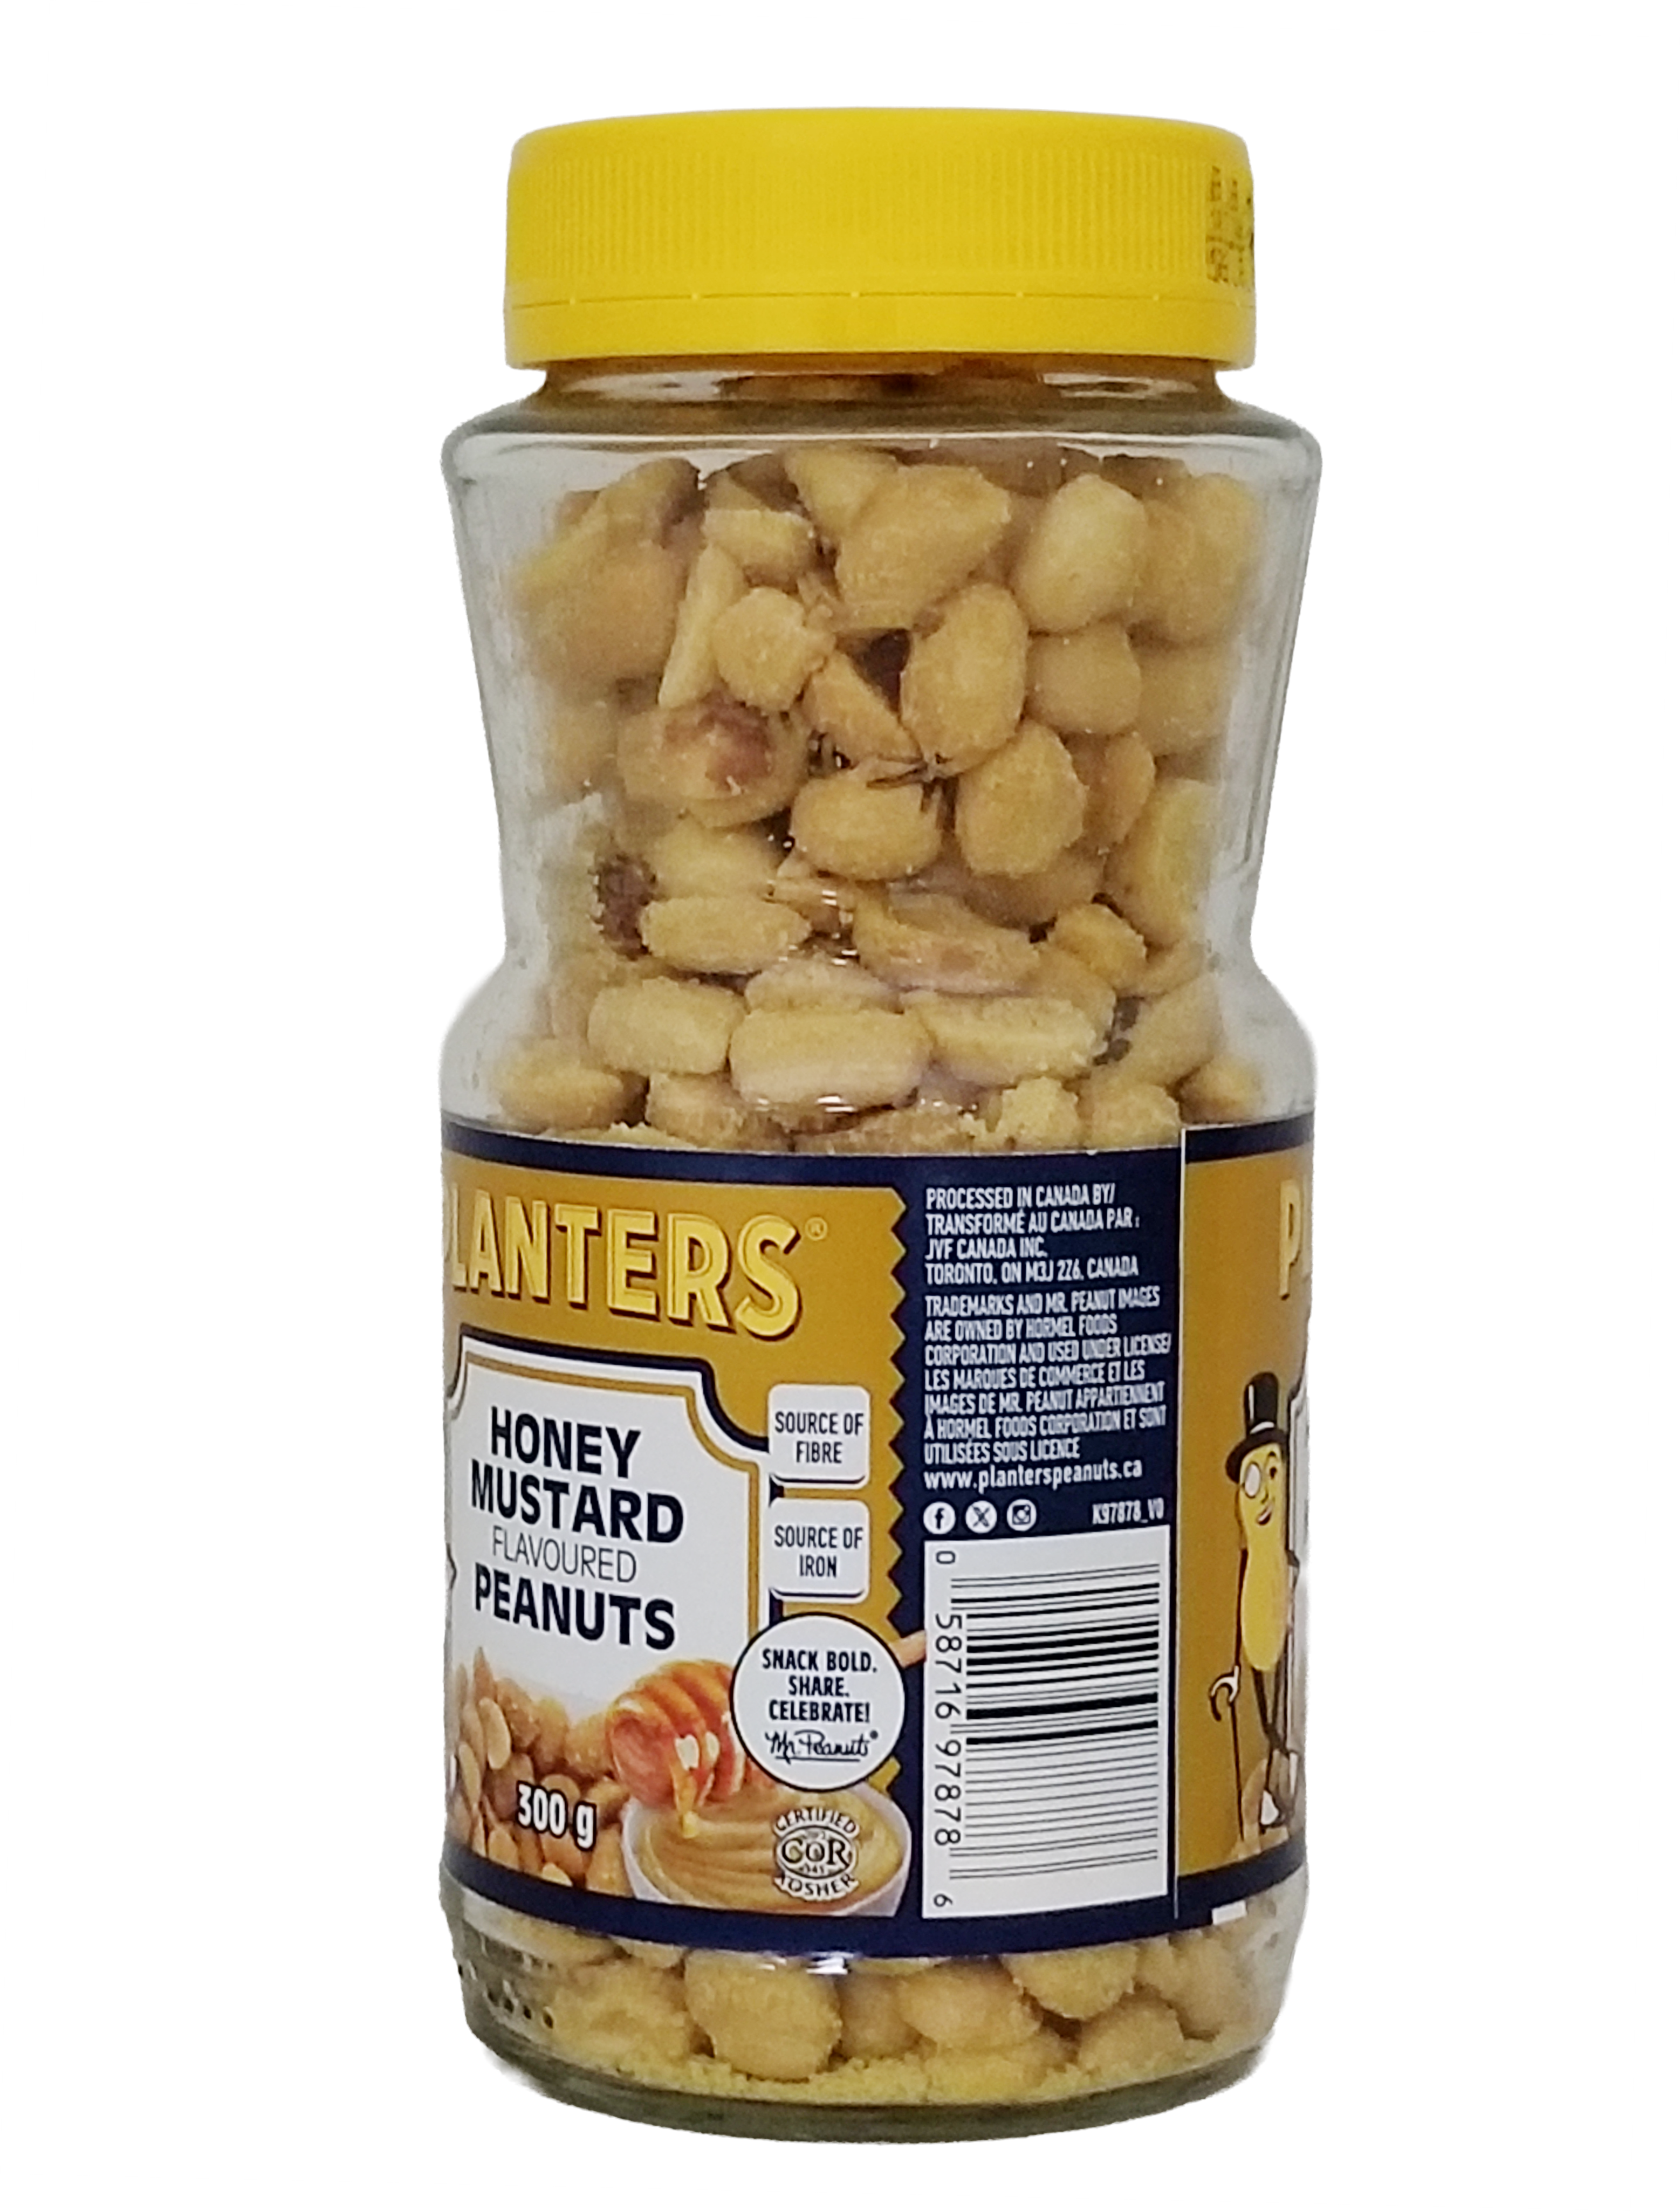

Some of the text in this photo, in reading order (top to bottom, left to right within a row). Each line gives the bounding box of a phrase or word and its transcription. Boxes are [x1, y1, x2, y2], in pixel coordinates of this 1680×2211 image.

[925, 1183, 1115, 1210] PROCESSED IN CANADA BY/
[925, 1208, 1025, 1235] TRANSFORMÉ
[1028, 1212, 1047, 1233] AU
[1051, 1209, 1103, 1232] CANADA
[925, 1235, 1047, 1261] JVF CANADA INC.
[1001, 1261, 1021, 1283] ON
[1025, 1260, 1054, 1282] M3J
[1087, 1255, 1139, 1278] CANADA
[925, 1285, 1160, 1317] TRADEMARKS AND MR. PEANUT IMAGES
[924, 1313, 1117, 1342] ARE OWNED BY HORMEL FOODS
[924, 1343, 1016, 1366] CORPORATION
[1019, 1342, 1045, 1364] AND
[1048, 1340, 1079, 1362] USED
[1082, 1337, 1121, 1361] UNDER
[924, 1359, 1145, 1391] LES MARQUES DE COMMERCE ET LES
[924, 1381, 1165, 1416] IMAGES DE MR. PEANUT APPARTIENNENT
[775, 1411, 864, 1435] SOURCE OF
[924, 1404, 1167, 1440] À HORMEL FOODS CORPORATION ET SONT
[491, 1406, 641, 1479] HONEY
[796, 1440, 842, 1464] FIBRE
[924, 1437, 1081, 1465] UTILISÉES SOUS LICENCE
[924, 1458, 1143, 1494] www.planterspeanuts.ca
[470, 1459, 684, 1543] MUSTARD
[774, 1525, 863, 1549] SOURCE OF
[492, 1525, 636, 1583] FLAVOURED
[799, 1555, 837, 1578] IRON
[935, 1550, 957, 1565] 0
[475, 1563, 676, 1651] PEANUTS
[762, 1648, 877, 1673] SNACK BOLD.
[935, 1613, 963, 1720] 58716
[788, 1676, 850, 1698] SHARE.
[769, 1699, 870, 1723] CELEBRATE!
[935, 1740, 962, 1846] 97878
[517, 1783, 596, 1850] 300 g
[776, 1807, 856, 1834] CERTIFIED
[933, 1893, 953, 1907] 6
